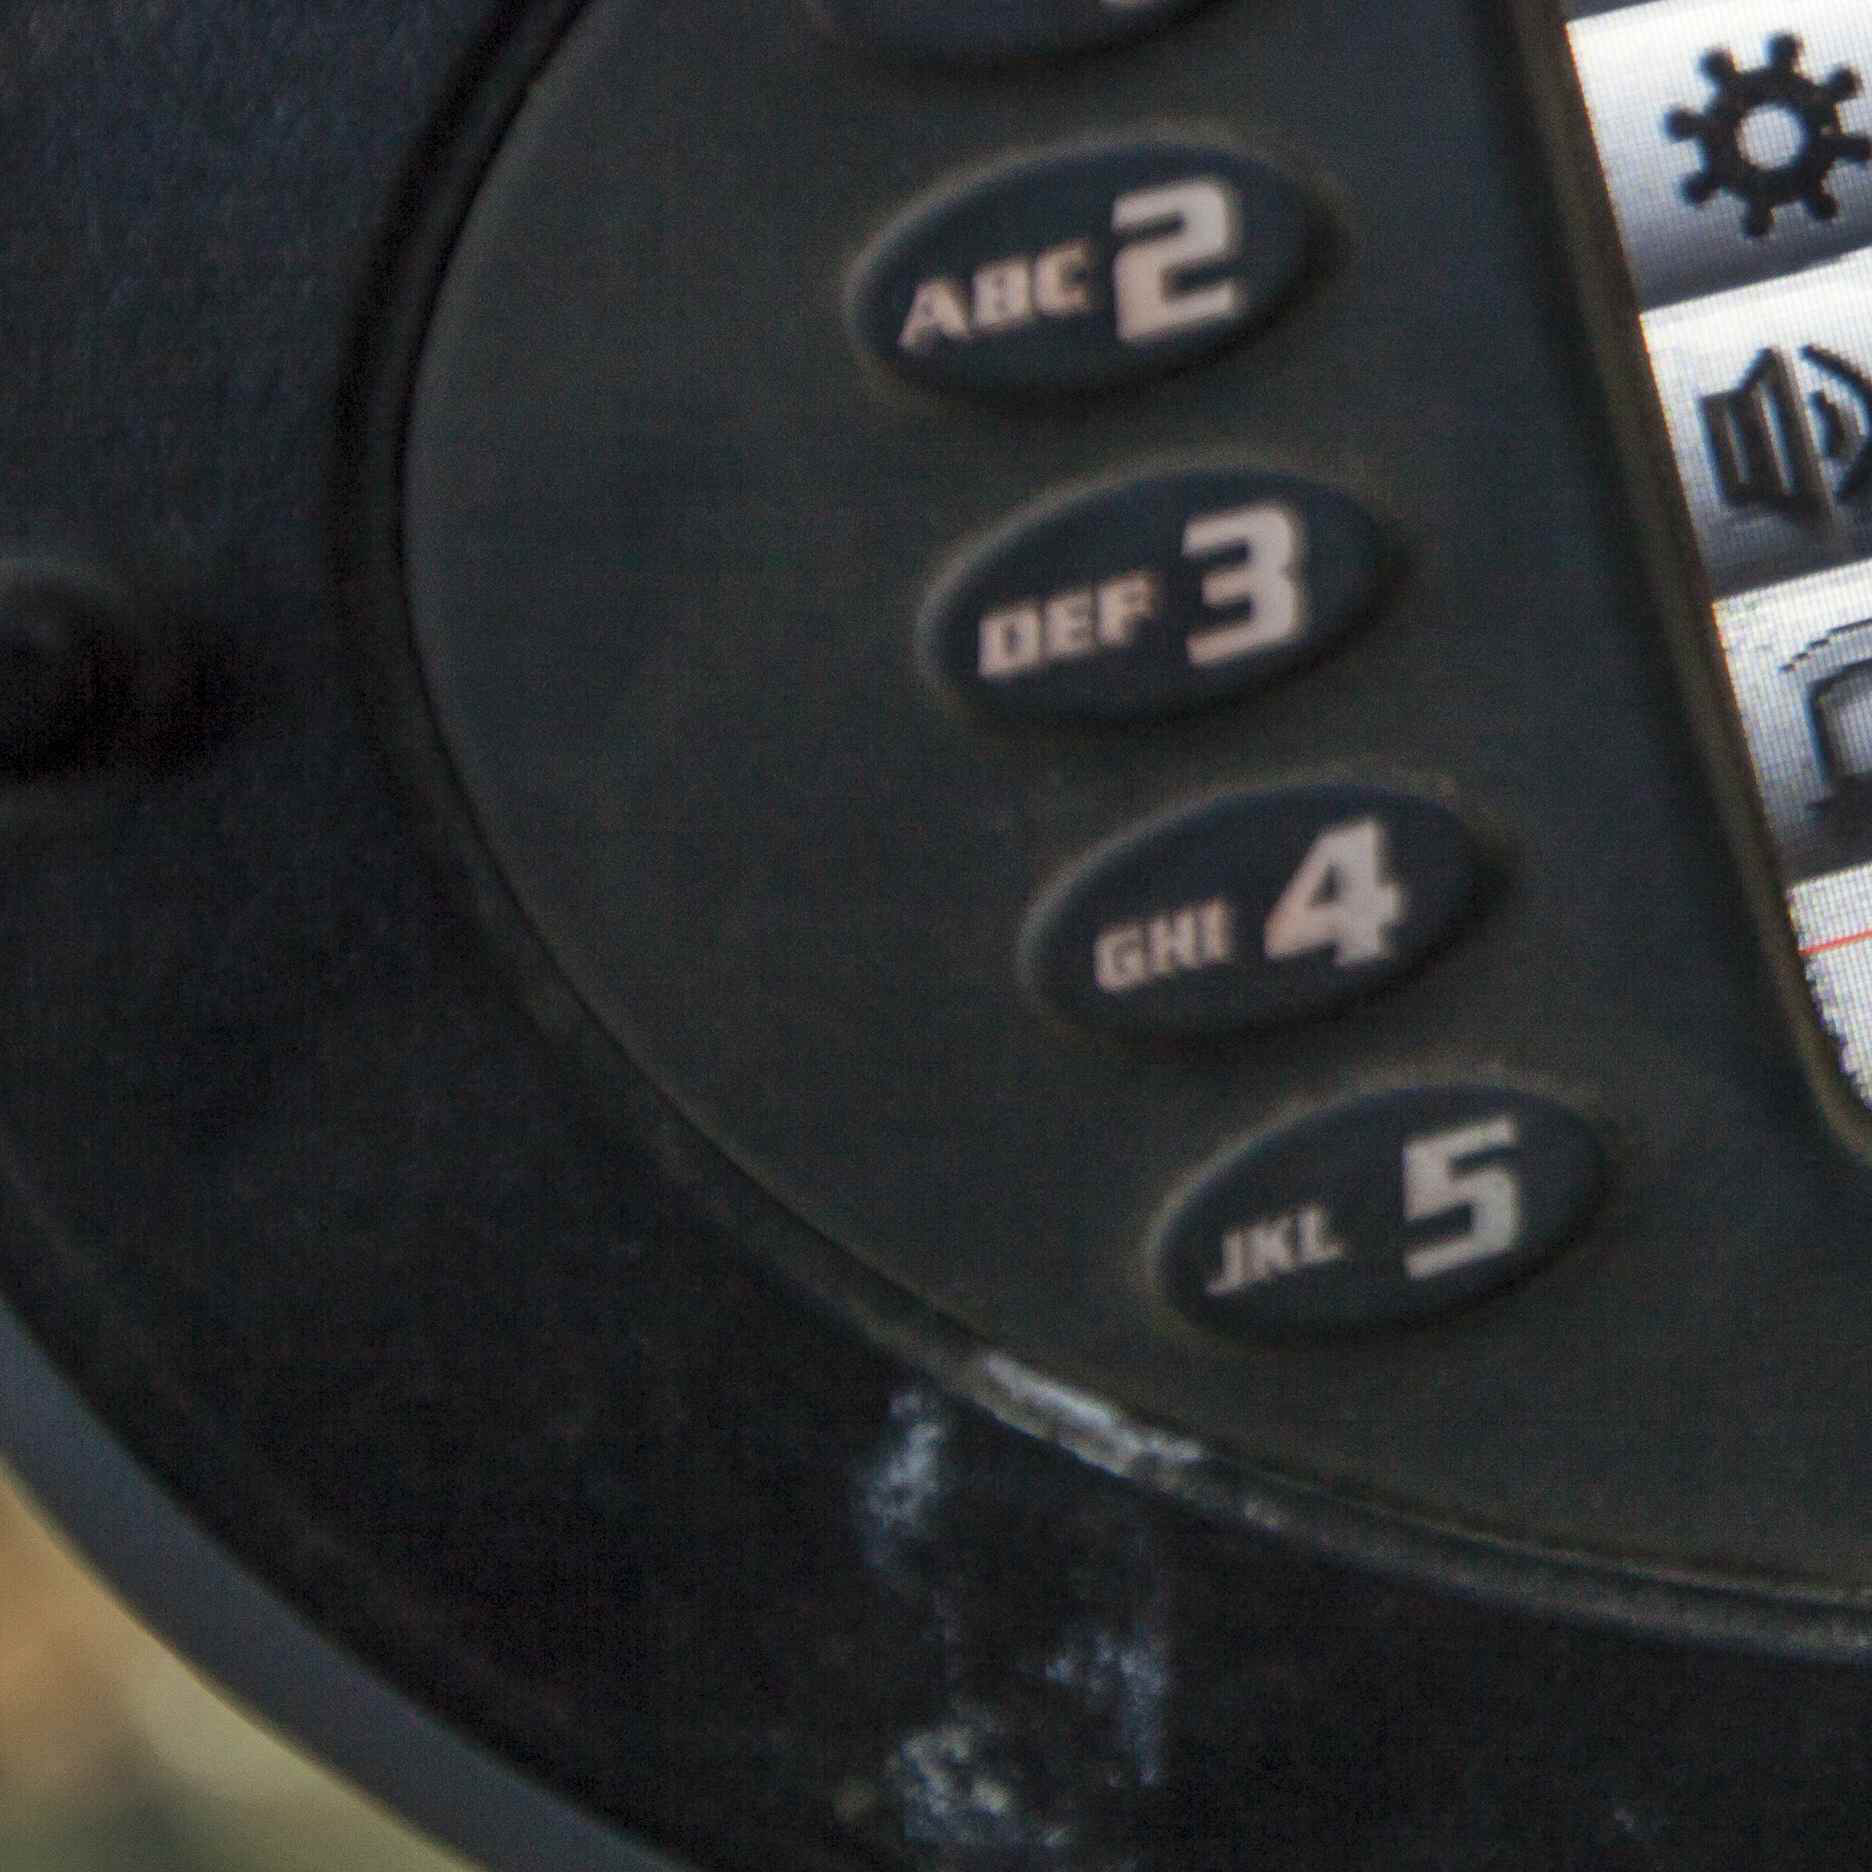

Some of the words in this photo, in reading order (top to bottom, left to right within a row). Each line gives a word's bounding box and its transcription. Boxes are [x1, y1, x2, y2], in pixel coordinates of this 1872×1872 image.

[896, 236, 1092, 353] ABC
[1114, 178, 1238, 344] 2
[977, 569, 1160, 682] DEF
[1181, 504, 1305, 665] 3
[1095, 900, 1233, 995] GHI
[1263, 817, 1401, 967] 4
[1207, 1204, 1349, 1297] JKL
[1402, 1116, 1518, 1280] 5
